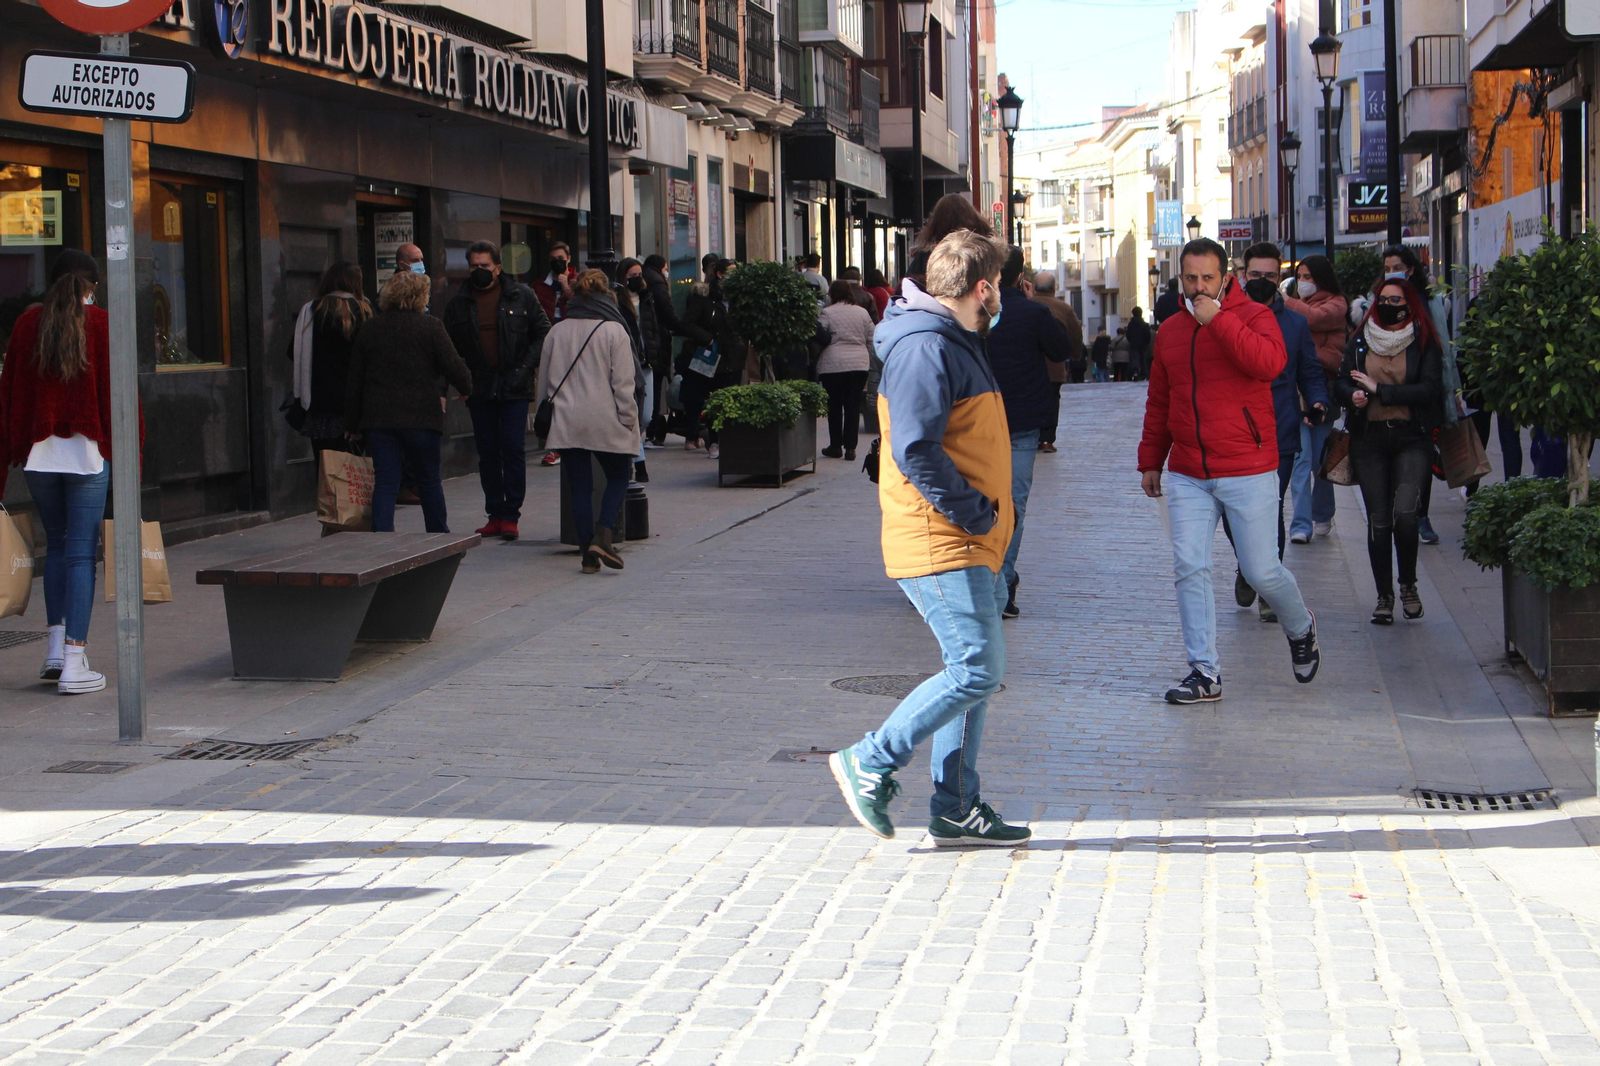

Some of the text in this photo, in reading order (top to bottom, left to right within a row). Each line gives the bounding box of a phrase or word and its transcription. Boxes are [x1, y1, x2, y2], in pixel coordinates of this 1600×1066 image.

[72, 63, 139, 86] EXCEPTO
[268, 0, 642, 149] RELOJERIA ROLDAN OTICA
[52, 85, 155, 111] AUTORIZADOS
[1158, 238, 1181, 246] PIZZERIA
[1220, 227, 1251, 238] aras
[969, 815, 992, 835] N
